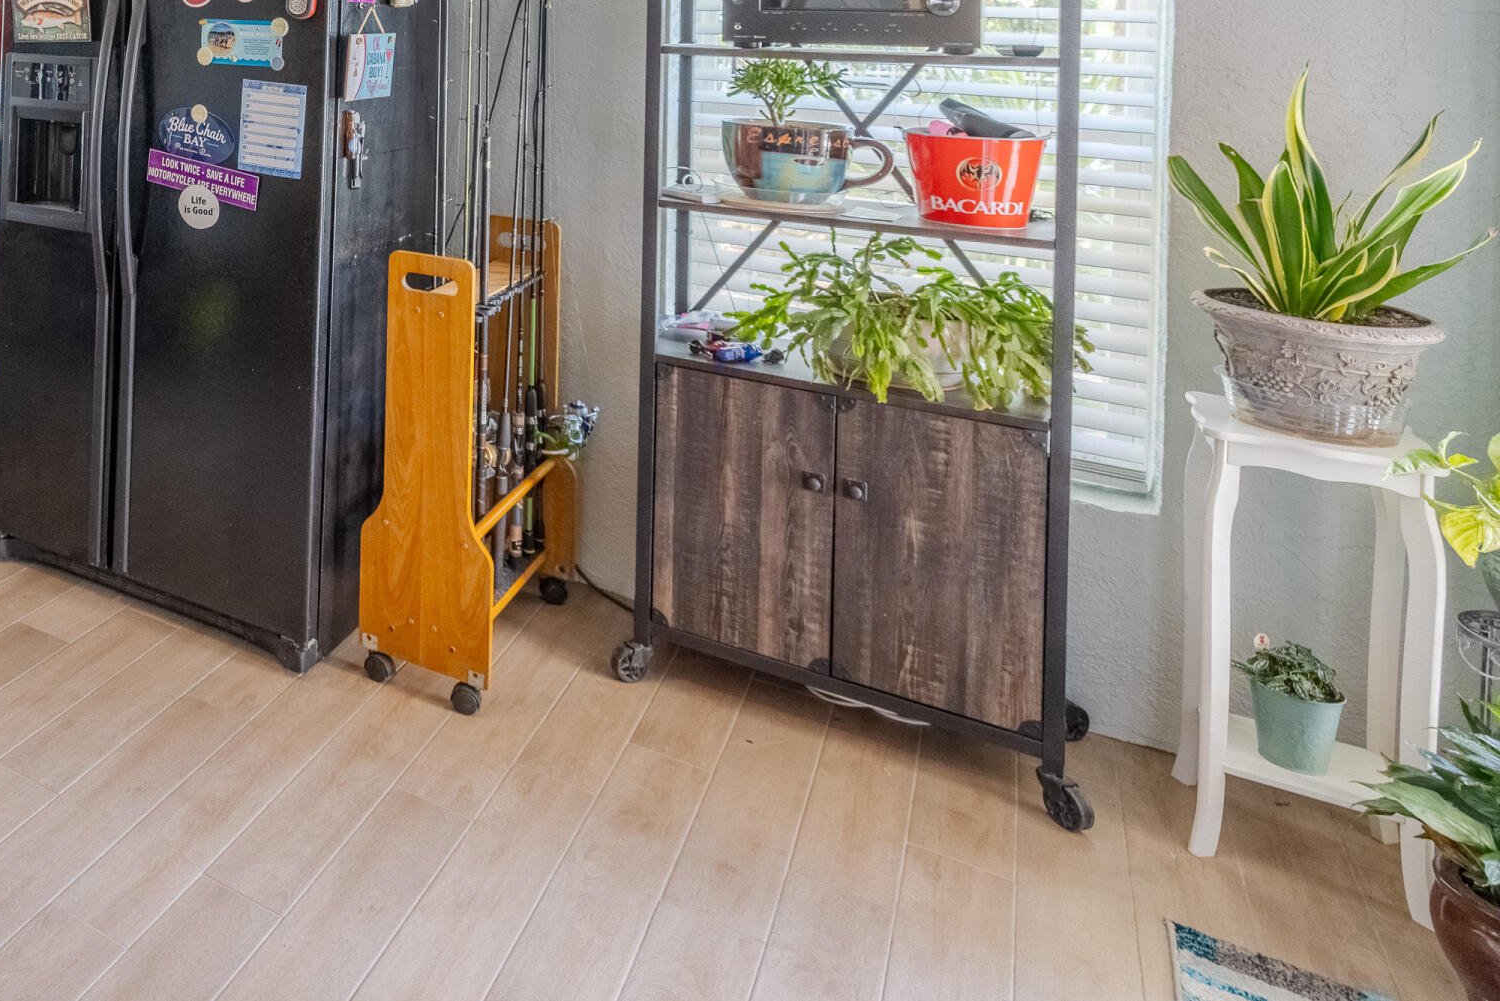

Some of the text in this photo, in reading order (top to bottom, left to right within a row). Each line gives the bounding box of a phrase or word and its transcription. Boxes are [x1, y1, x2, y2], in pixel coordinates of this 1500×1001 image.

[167, 116, 226, 144] Blue Chair
[183, 134, 207, 148] BAY
[161, 157, 179, 170] LOOK
[180, 161, 201, 176] TWICE
[206, 168, 223, 182] SAVE
[224, 174, 230, 183] A
[230, 176, 245, 188] LIFE
[148, 166, 196, 186] MOTORCYCLES
[211, 182, 256, 206] EVERYWHERE
[184, 205, 213, 216] is Good
[191, 196, 207, 206] Life
[930, 195, 1024, 216] BACARDI
